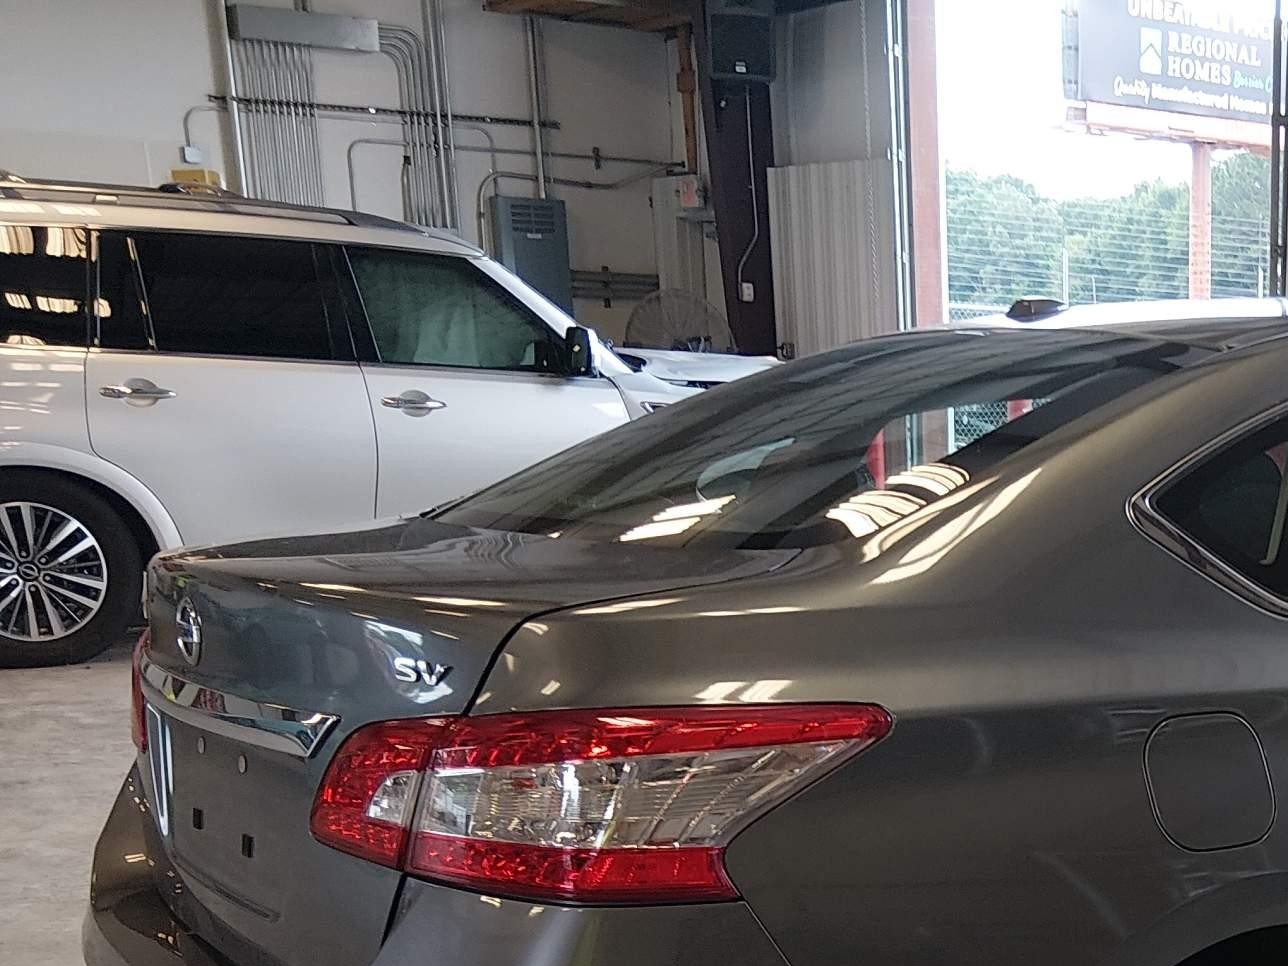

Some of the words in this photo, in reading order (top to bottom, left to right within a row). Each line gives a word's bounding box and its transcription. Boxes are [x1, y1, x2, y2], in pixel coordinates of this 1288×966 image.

[1168, 31, 1261, 66] REGIONAL
[1167, 55, 1232, 85] HOMES
[394, 656, 452, 687] SV
